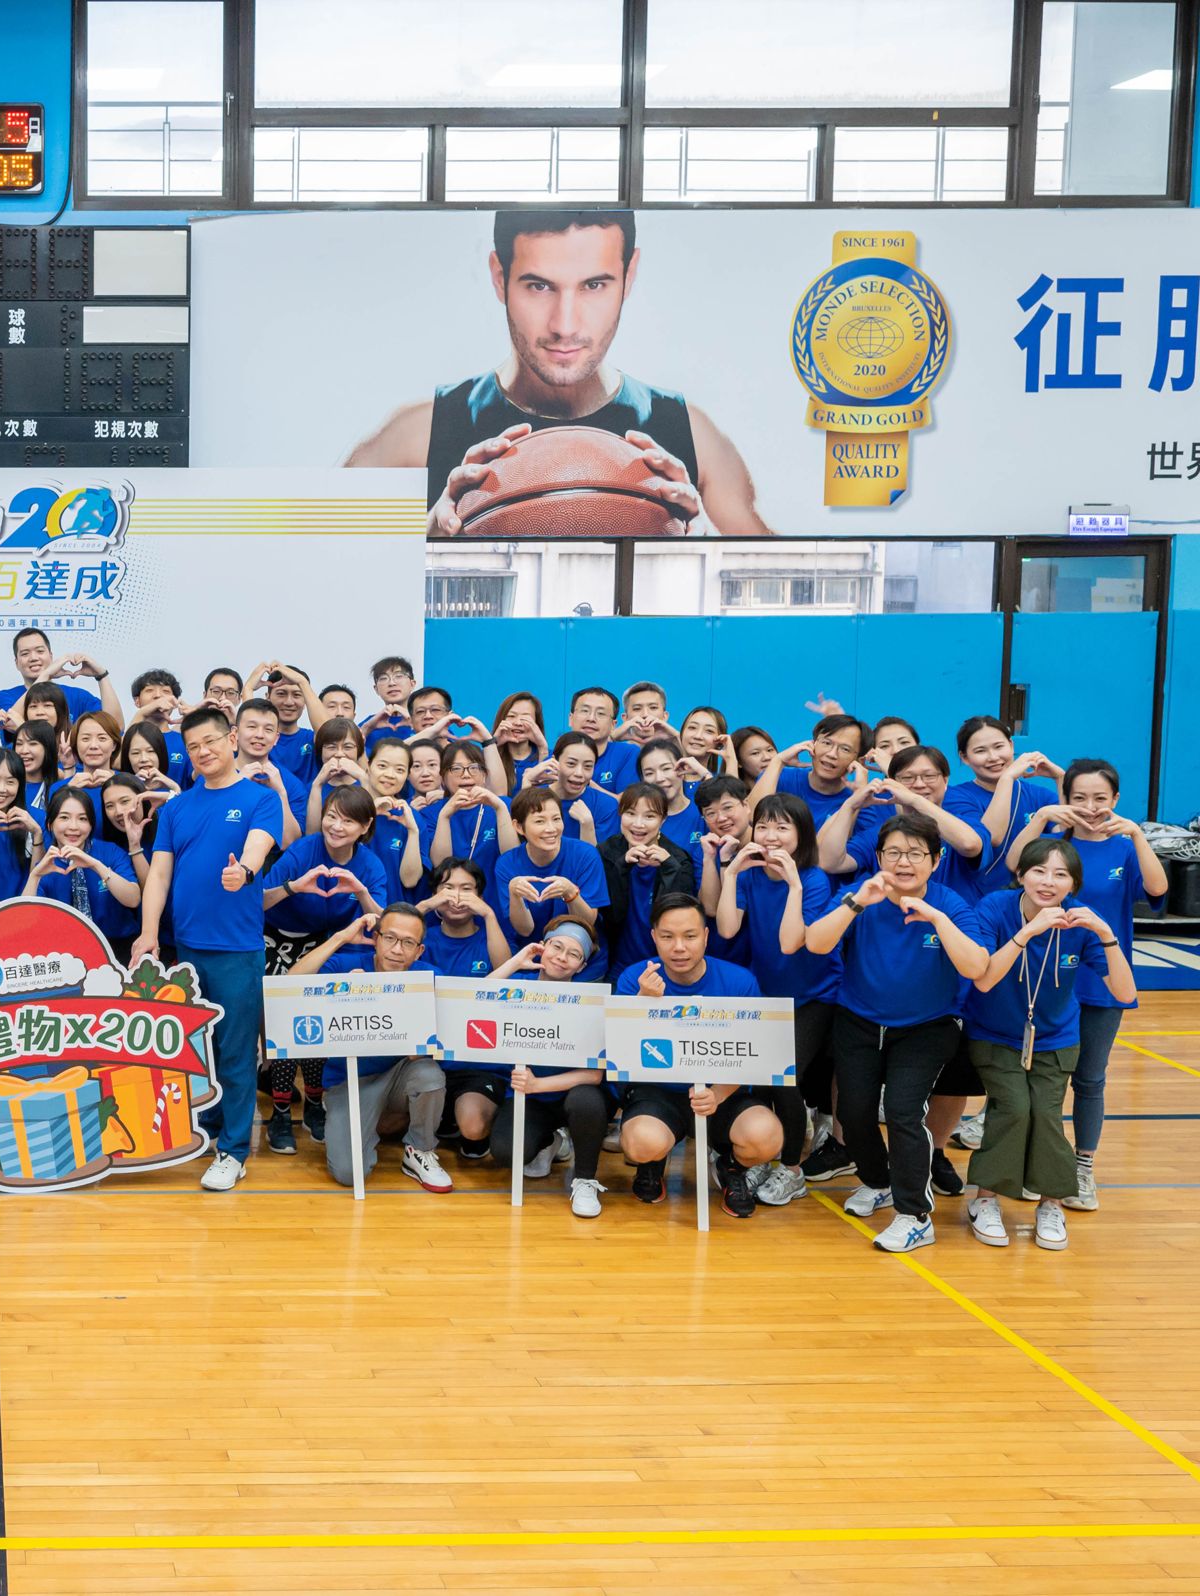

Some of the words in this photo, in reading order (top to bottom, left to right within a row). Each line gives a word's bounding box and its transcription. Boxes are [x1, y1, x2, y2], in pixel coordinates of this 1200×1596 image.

[842, 237, 877, 247] SINCE
[881, 238, 905, 247] 1961
[815, 285, 857, 341] MONDE
[860, 280, 926, 341] SELECTION
[853, 364, 887, 376] 2020
[813, 409, 873, 426] GRAND
[876, 409, 924, 426] GOLD
[94, 419, 159, 438] 犯規次數
[832, 443, 900, 463] QUALITY
[832, 465, 900, 478] AWARD
[4, 960, 62, 980] 百達醫療
[328, 1015, 393, 1031] ARTISS
[503, 1022, 560, 1039] Floseal
[329, 1033, 366, 1042] Solutions
[367, 1032, 378, 1041] for
[379, 1031, 408, 1041] Sealant
[502, 1039, 548, 1049] Hemostatic
[550, 1041, 576, 1051] Matrix
[679, 1040, 759, 1057] TISSEEL
[679, 1057, 705, 1067] Fibrin
[708, 1058, 743, 1068] Sealant
